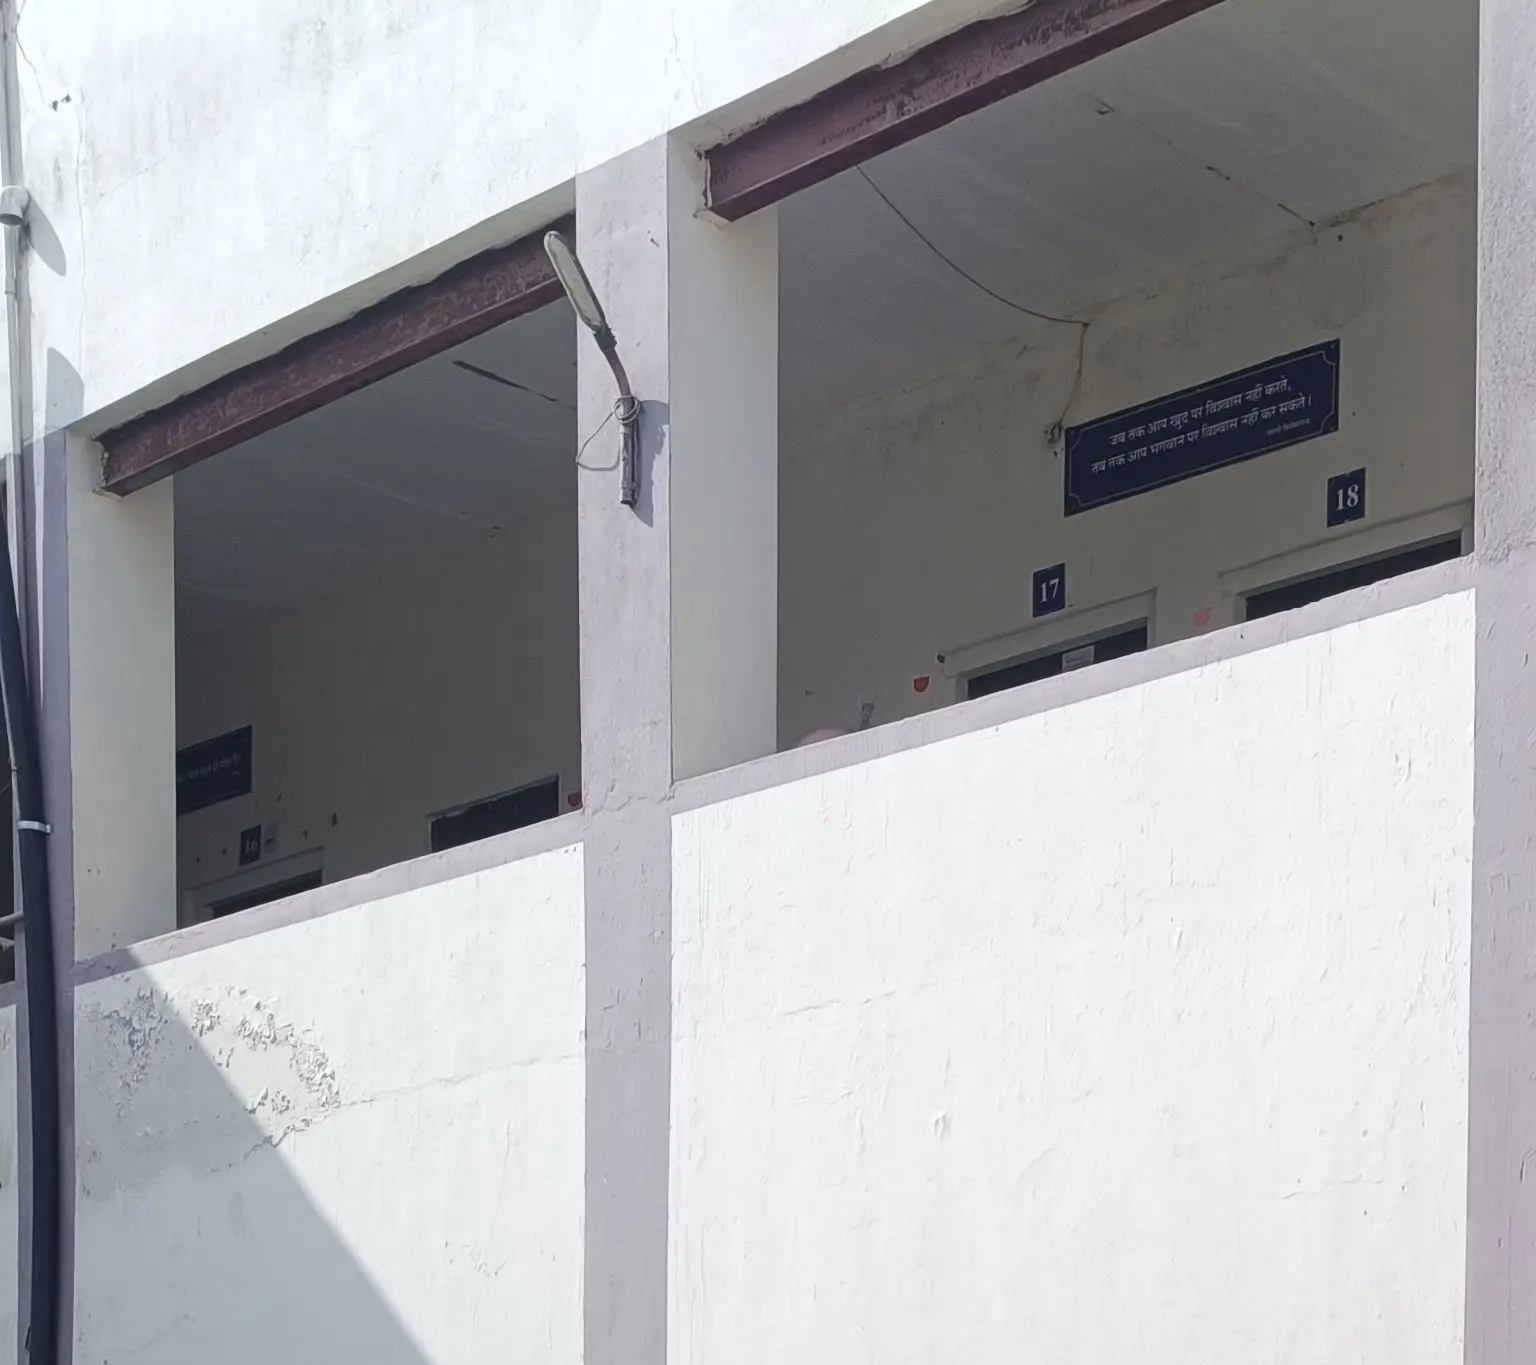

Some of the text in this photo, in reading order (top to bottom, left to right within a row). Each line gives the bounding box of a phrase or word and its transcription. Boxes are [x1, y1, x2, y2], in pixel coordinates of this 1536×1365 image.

[1127, 425, 1146, 440] तक
[1148, 417, 1168, 434] आप
[1169, 411, 1189, 429] खुद
[1190, 406, 1204, 419] पर
[1205, 394, 1243, 416] विश्वास
[1244, 383, 1263, 402] नहीं
[1091, 459, 1107, 474] तब
[1108, 453, 1126, 469] तक
[1127, 446, 1148, 463] आप
[1150, 434, 1185, 454] भगवान
[1186, 429, 1200, 443] पर
[1240, 406, 1260, 426] नहीं
[1260, 405, 1277, 419] कर
[1336, 484, 1359, 511] 18
[1040, 578, 1060, 603] 17
